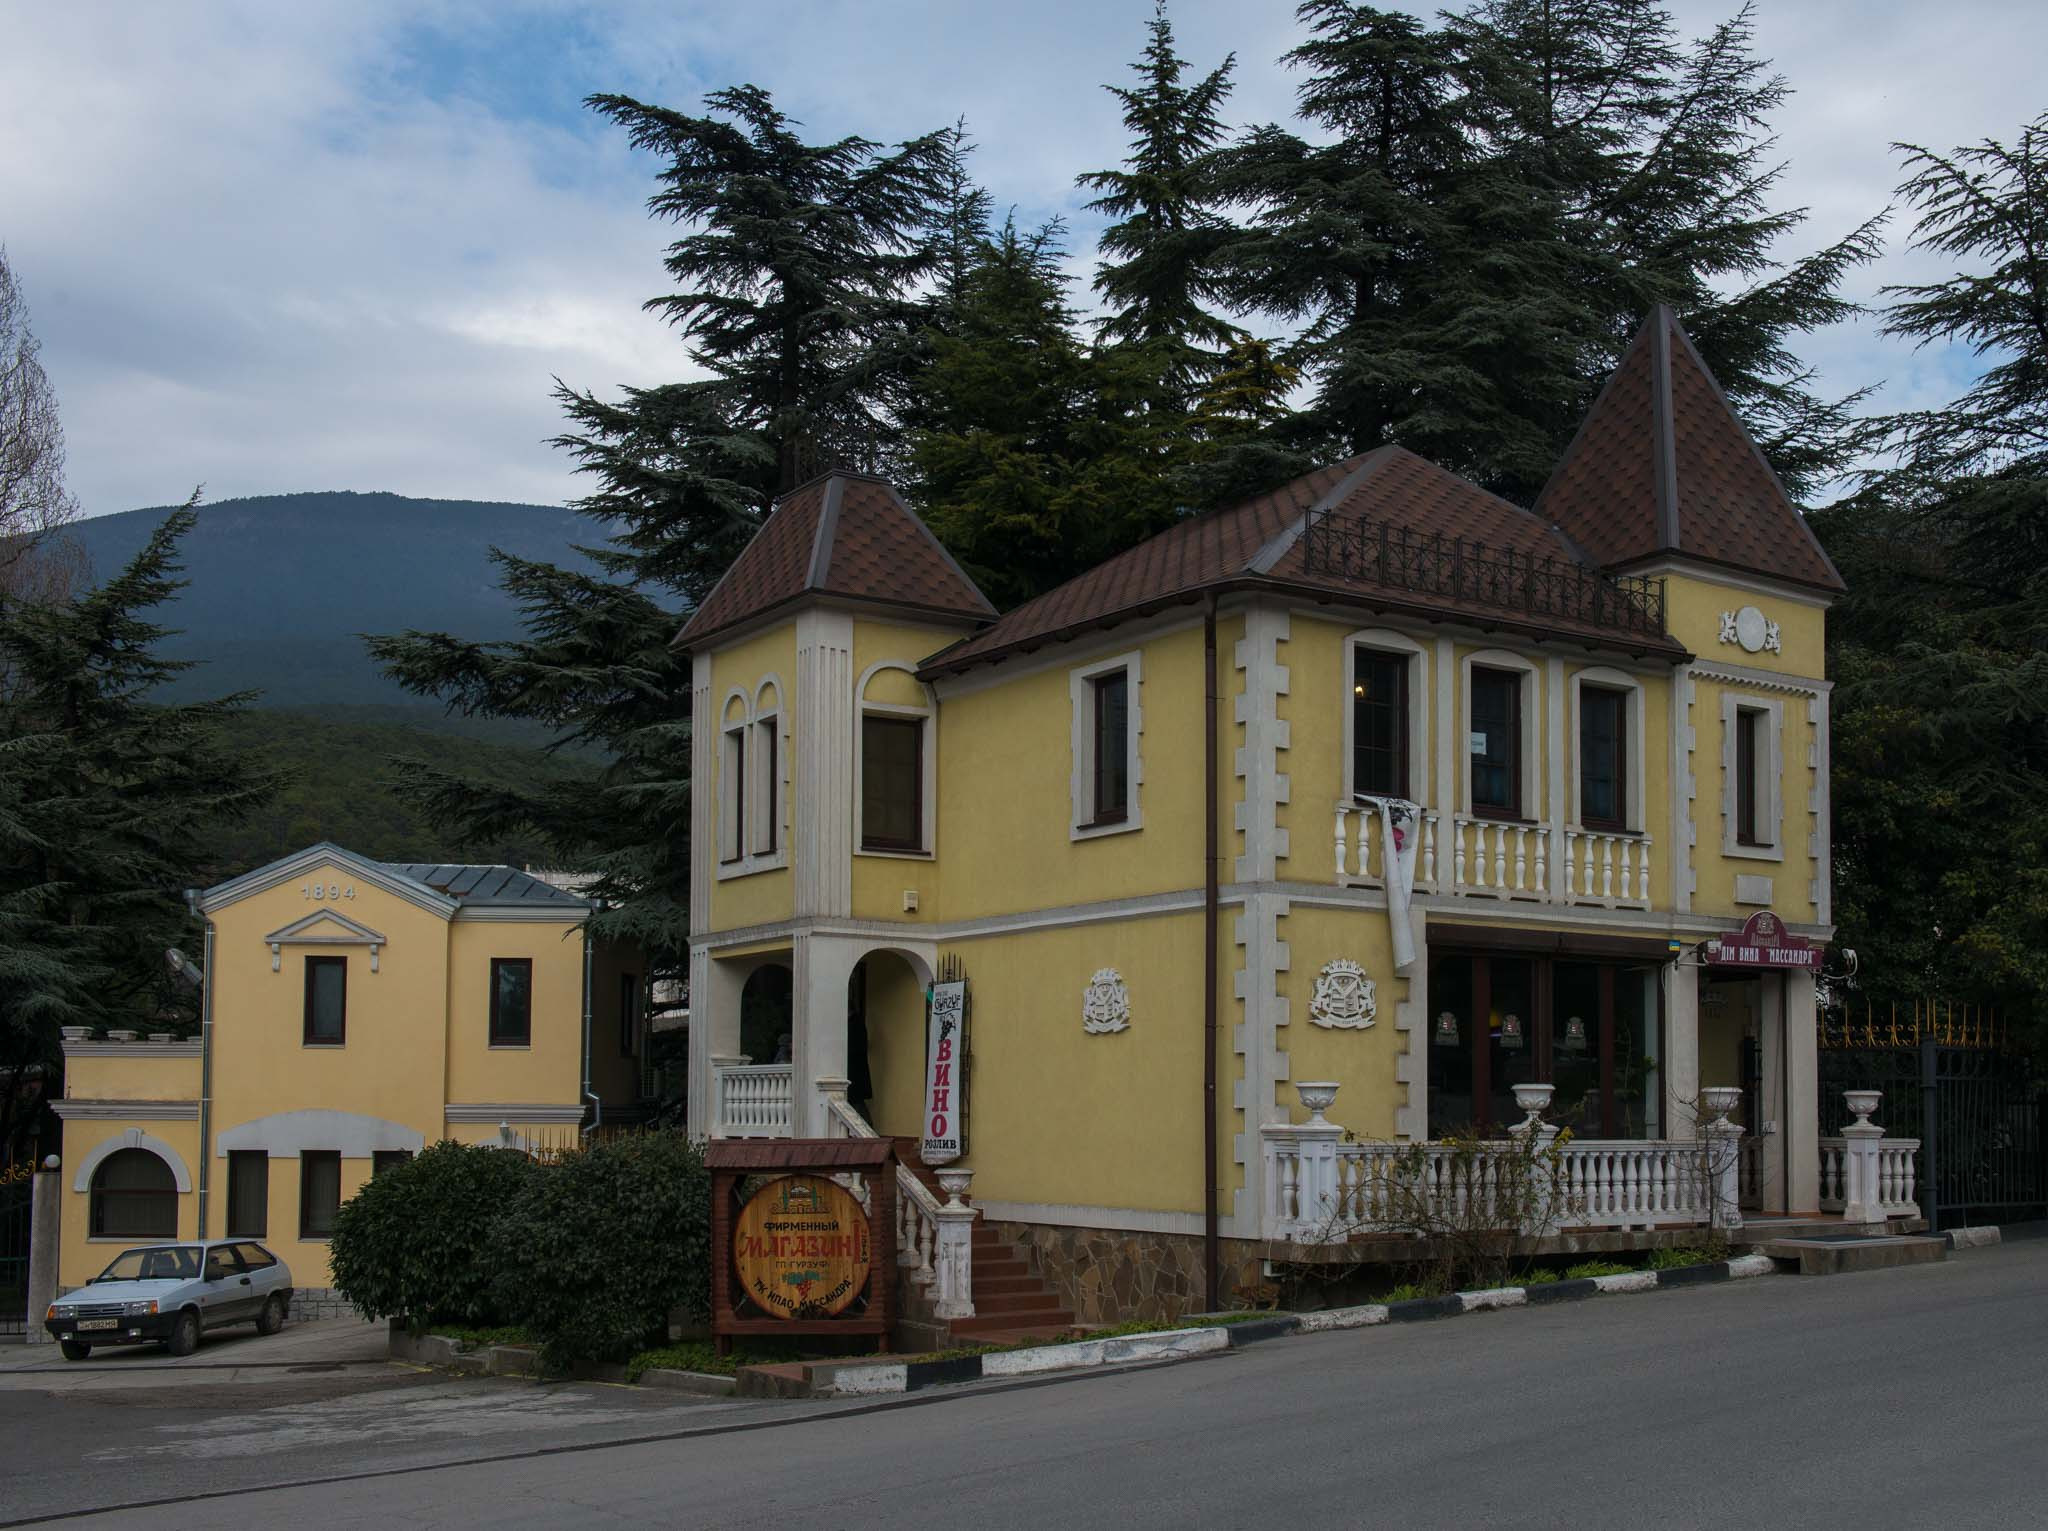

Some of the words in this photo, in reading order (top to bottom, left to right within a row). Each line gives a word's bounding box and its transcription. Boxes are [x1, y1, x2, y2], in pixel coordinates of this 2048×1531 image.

[300, 882, 356, 900] 1894
[1721, 946, 1735, 961] ДІМ
[931, 1039, 952, 1137] ВИНО
[924, 1138, 957, 1150] РОЗЛИВ
[764, 1220, 839, 1231] ФИРМЕННЫЙ
[738, 1236, 851, 1257] МАГАЗИН
